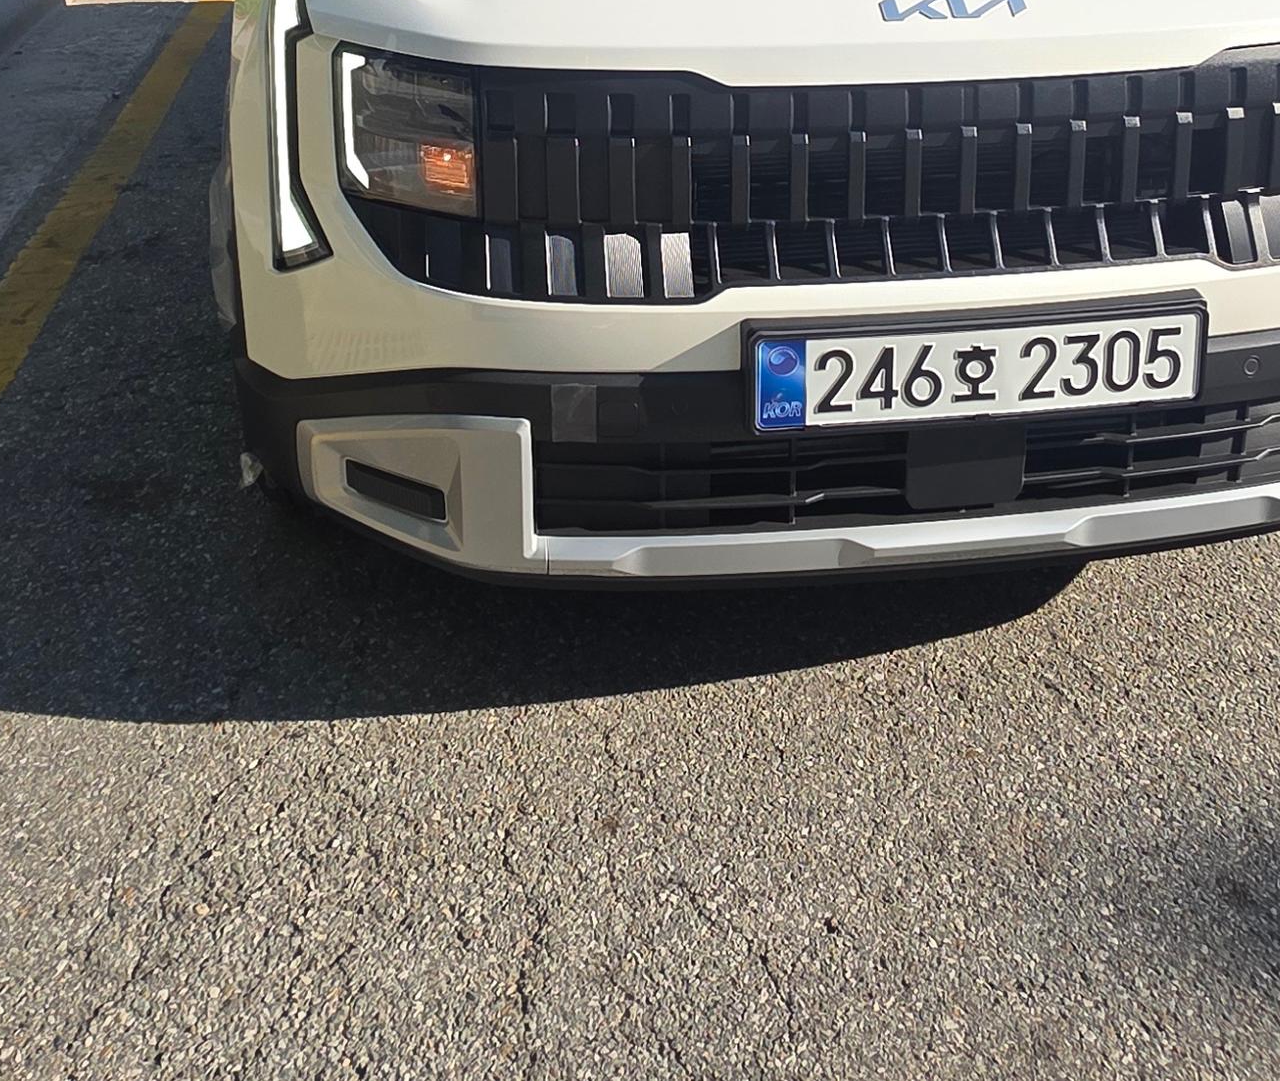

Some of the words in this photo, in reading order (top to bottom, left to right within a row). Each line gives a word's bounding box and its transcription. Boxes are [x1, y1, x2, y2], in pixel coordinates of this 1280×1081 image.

[812, 343, 997, 415] 246호
[1018, 326, 1183, 401] 2305
[762, 401, 803, 419] KOR
